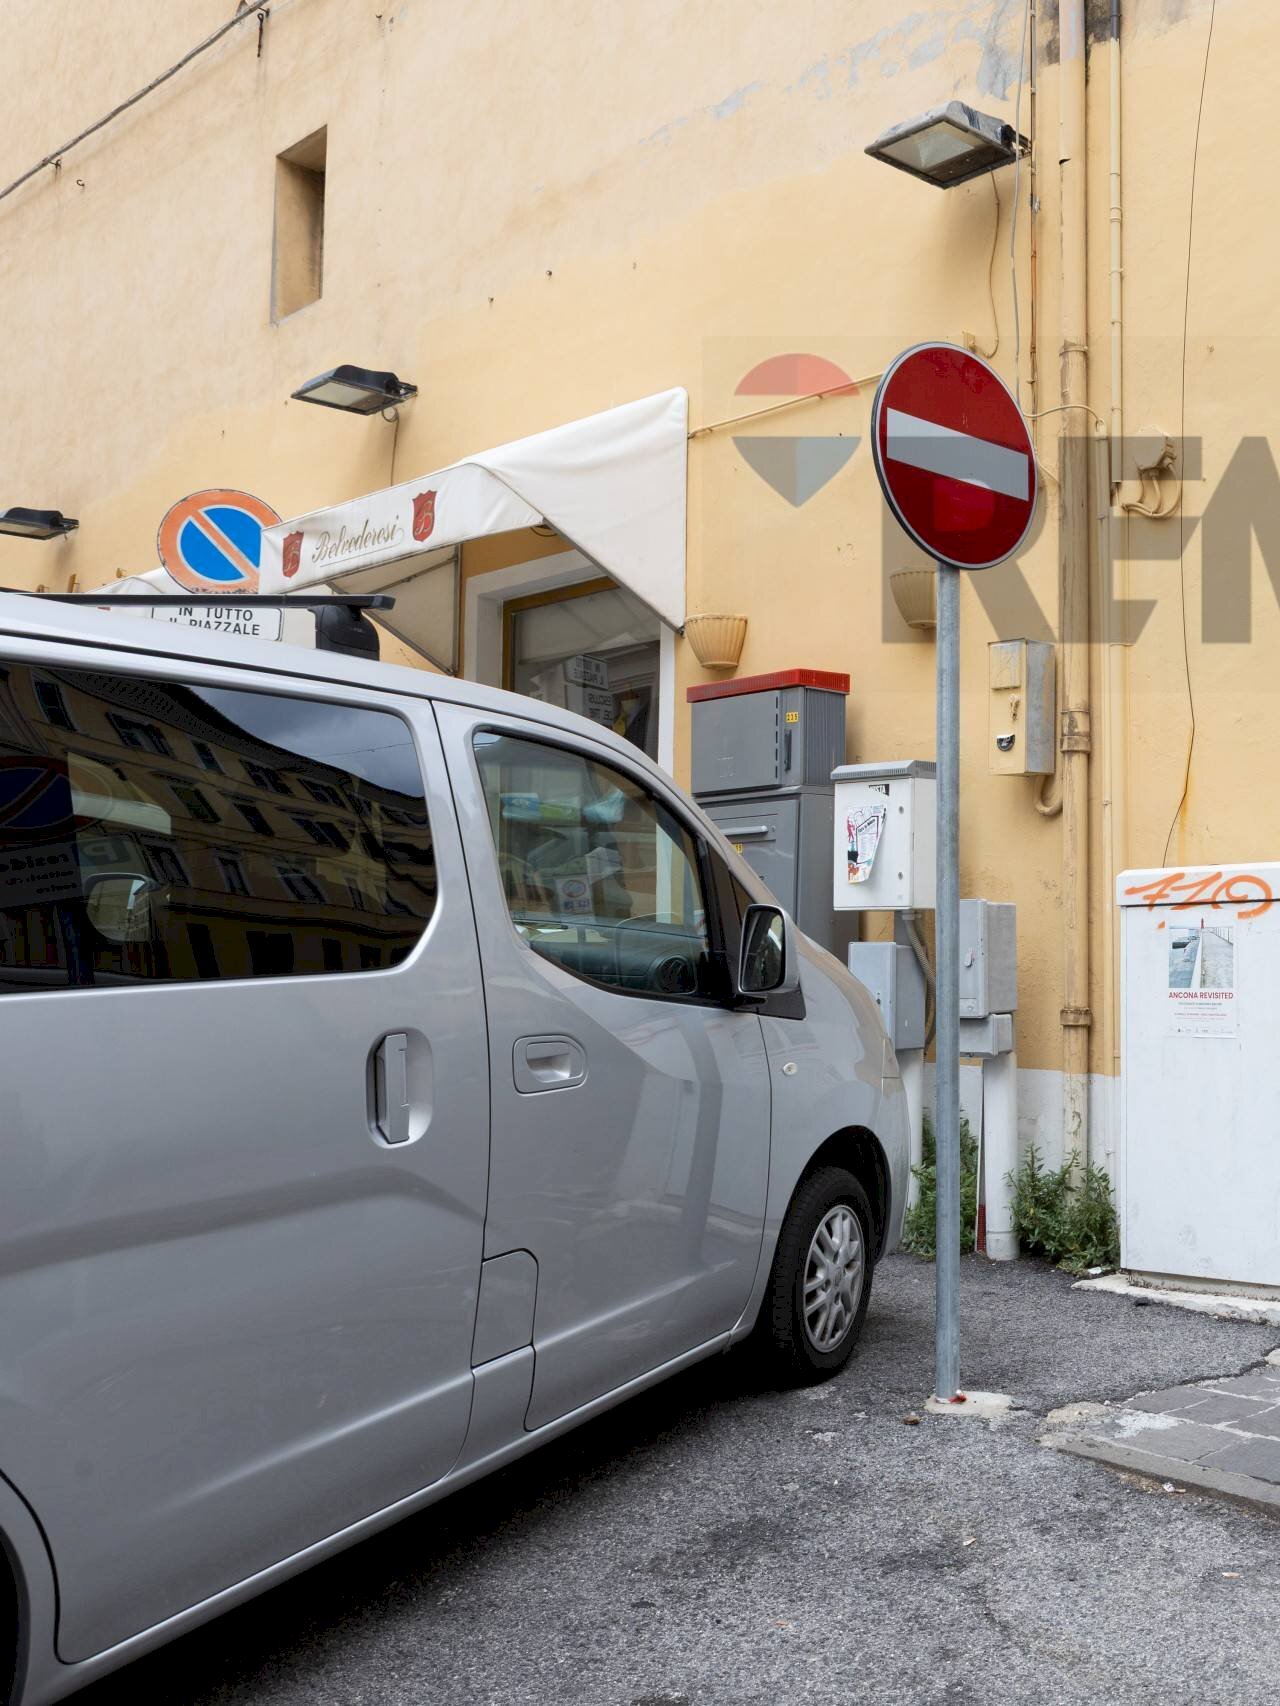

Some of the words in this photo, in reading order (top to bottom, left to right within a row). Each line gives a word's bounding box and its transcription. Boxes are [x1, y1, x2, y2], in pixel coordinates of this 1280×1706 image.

[312, 514, 402, 563] Belvederesi
[178, 607, 193, 617] IN
[206, 607, 253, 622] TUTTO
[1168, 991, 1198, 999] ANCONA
[1200, 991, 1234, 1000] REVISITED
